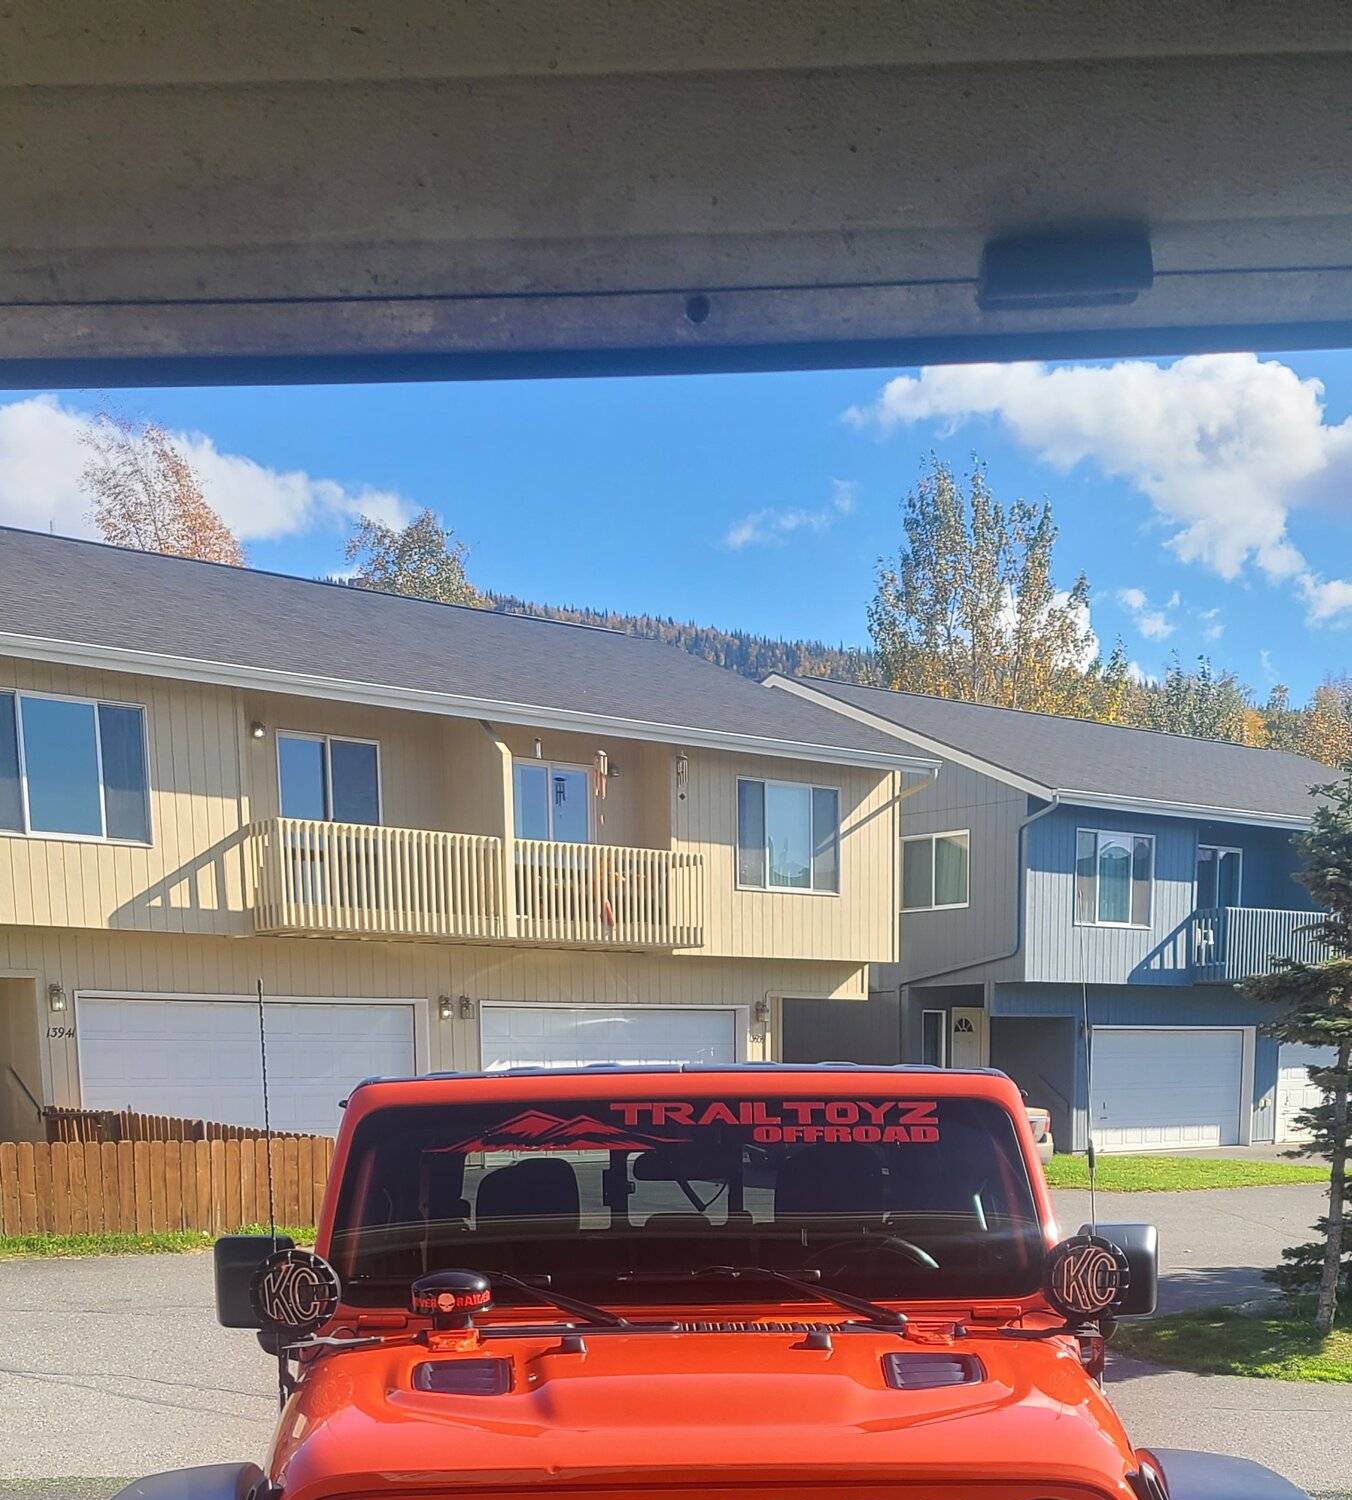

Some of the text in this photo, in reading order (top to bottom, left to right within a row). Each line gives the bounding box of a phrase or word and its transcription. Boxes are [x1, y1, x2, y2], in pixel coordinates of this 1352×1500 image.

[752, 1126, 940, 1143] OFFROAD
[262, 1263, 321, 1325] KC
[1063, 1248, 1117, 1310] KC
